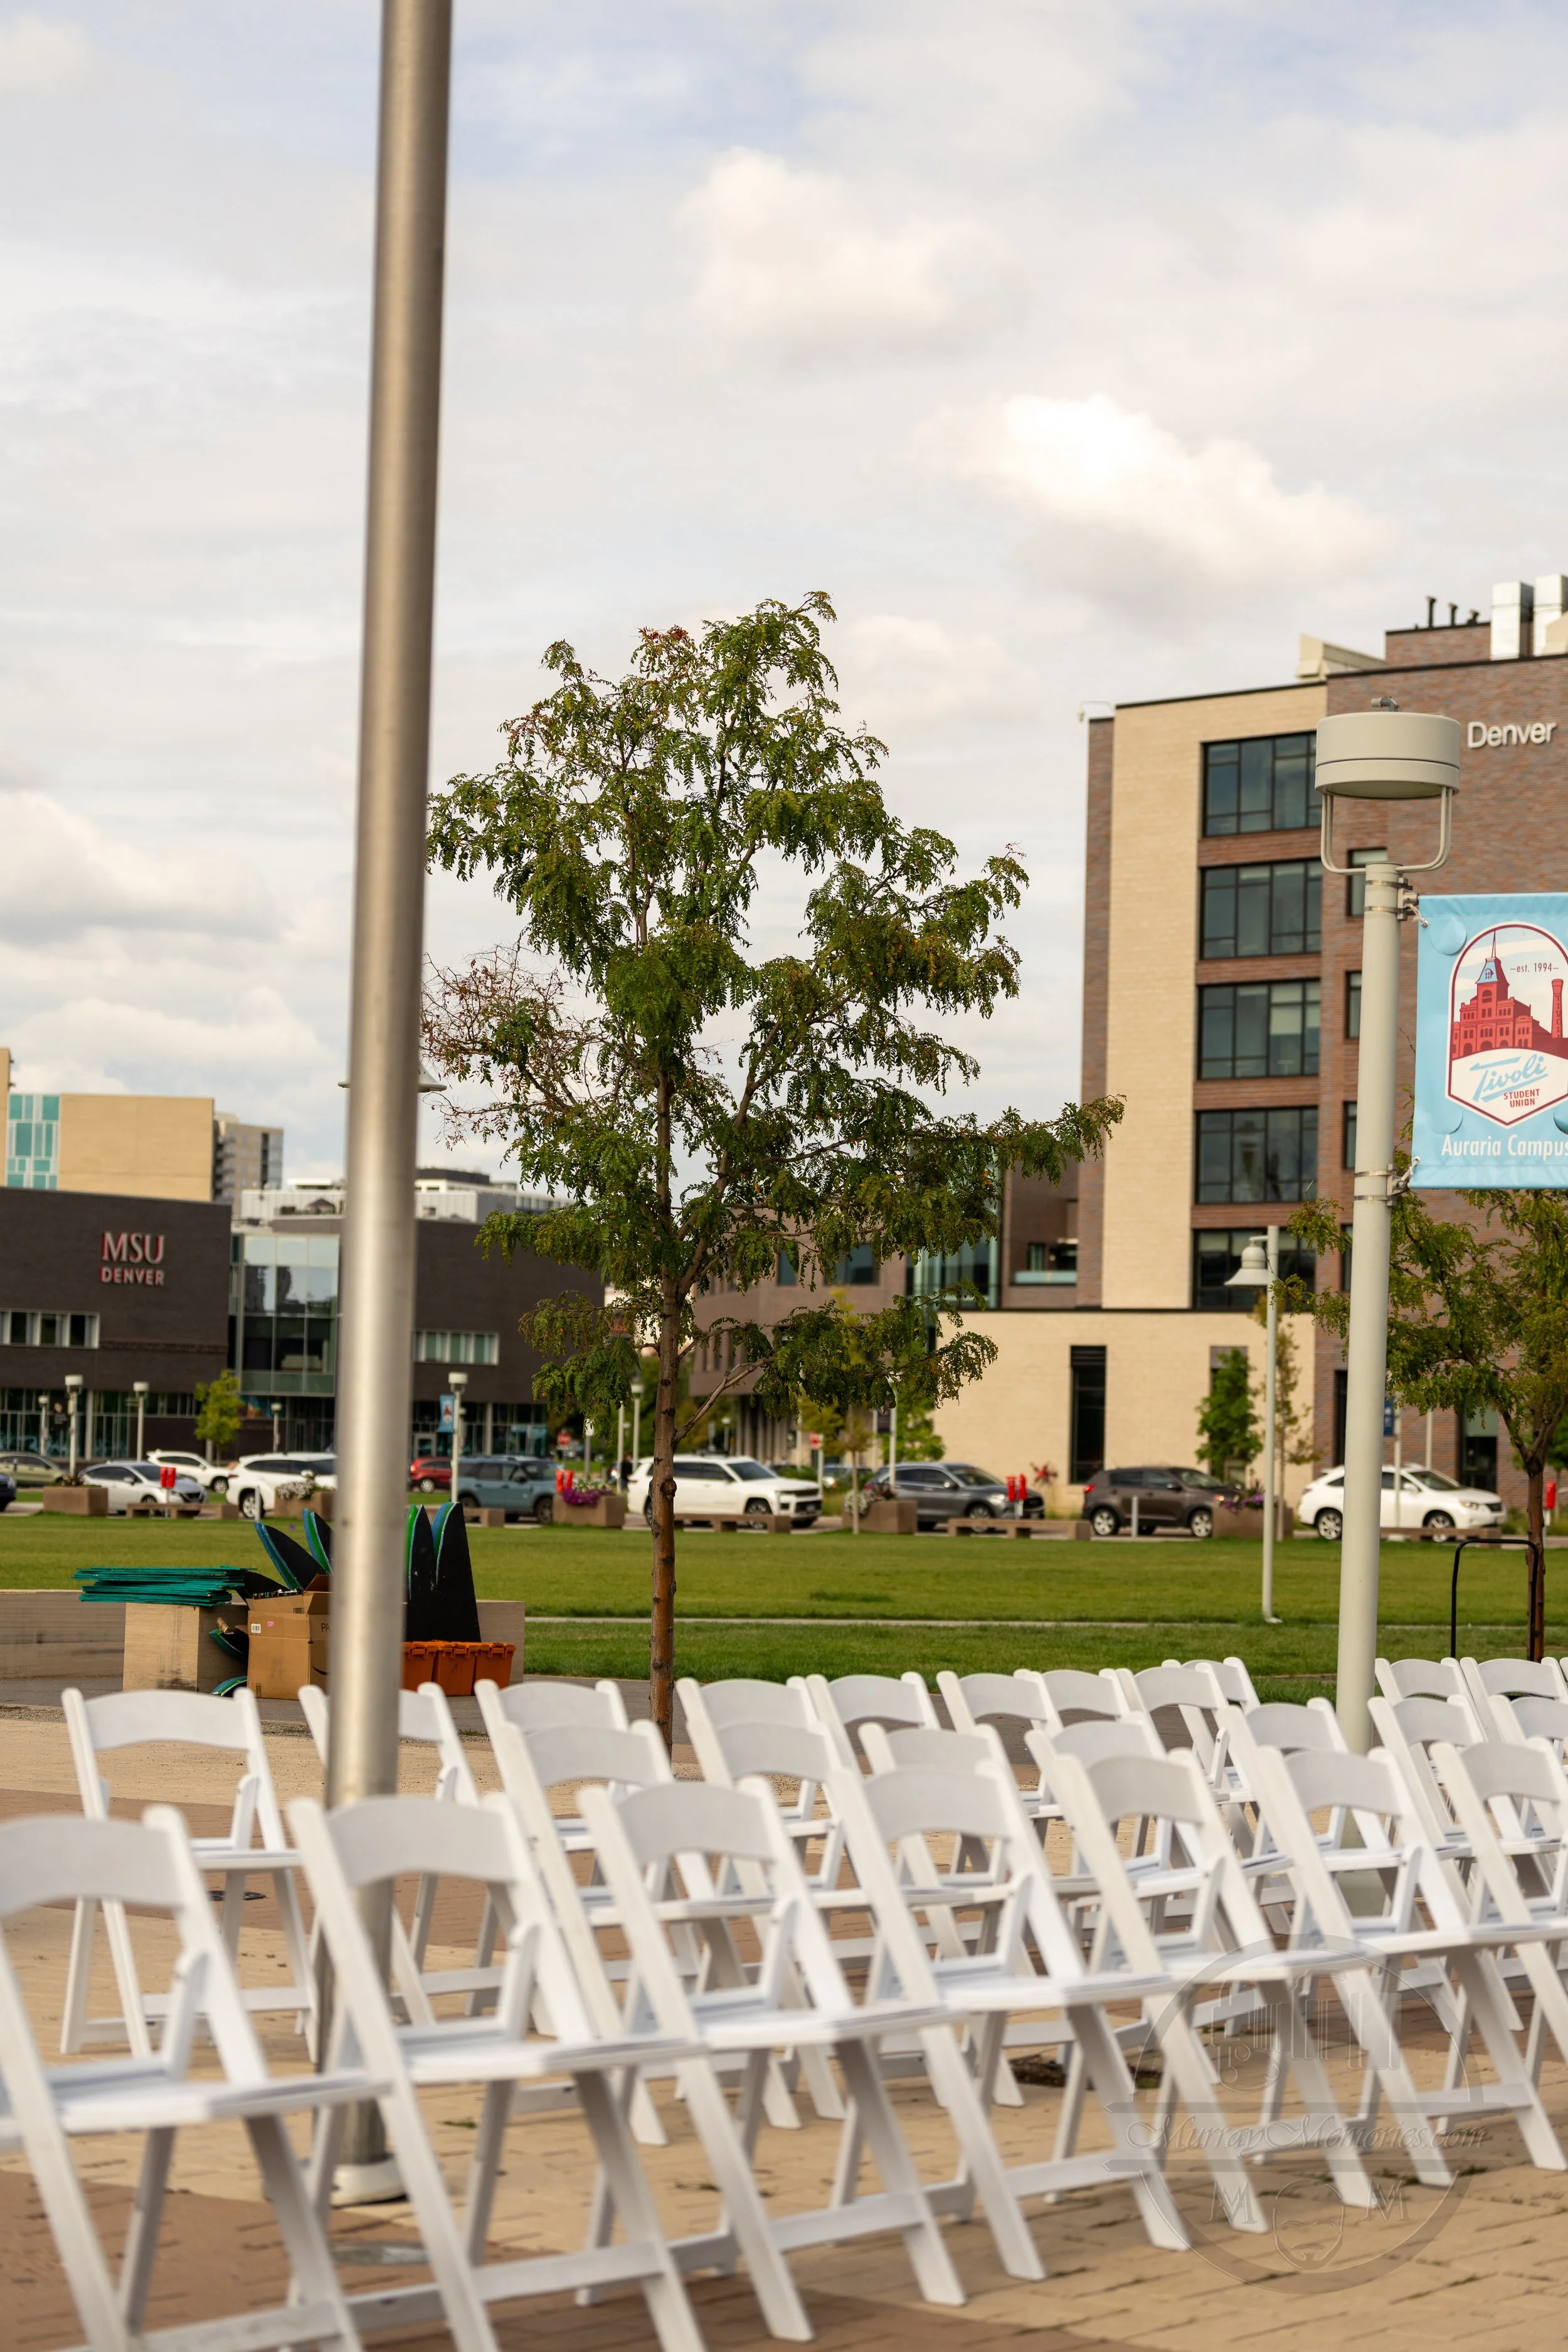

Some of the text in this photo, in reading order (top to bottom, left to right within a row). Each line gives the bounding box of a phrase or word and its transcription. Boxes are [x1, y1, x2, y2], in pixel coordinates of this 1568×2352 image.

[1467, 721, 1556, 749] Denver
[1534, 963, 1552, 973] 1994
[1470, 1054, 1547, 1102] Tivoli
[1503, 1088, 1540, 1100] STUDENT
[1510, 1098, 1535, 1108] UNION
[1441, 1134, 1502, 1156] Auraria
[102, 1231, 165, 1264] MSU
[100, 1266, 165, 1286] DENVER
